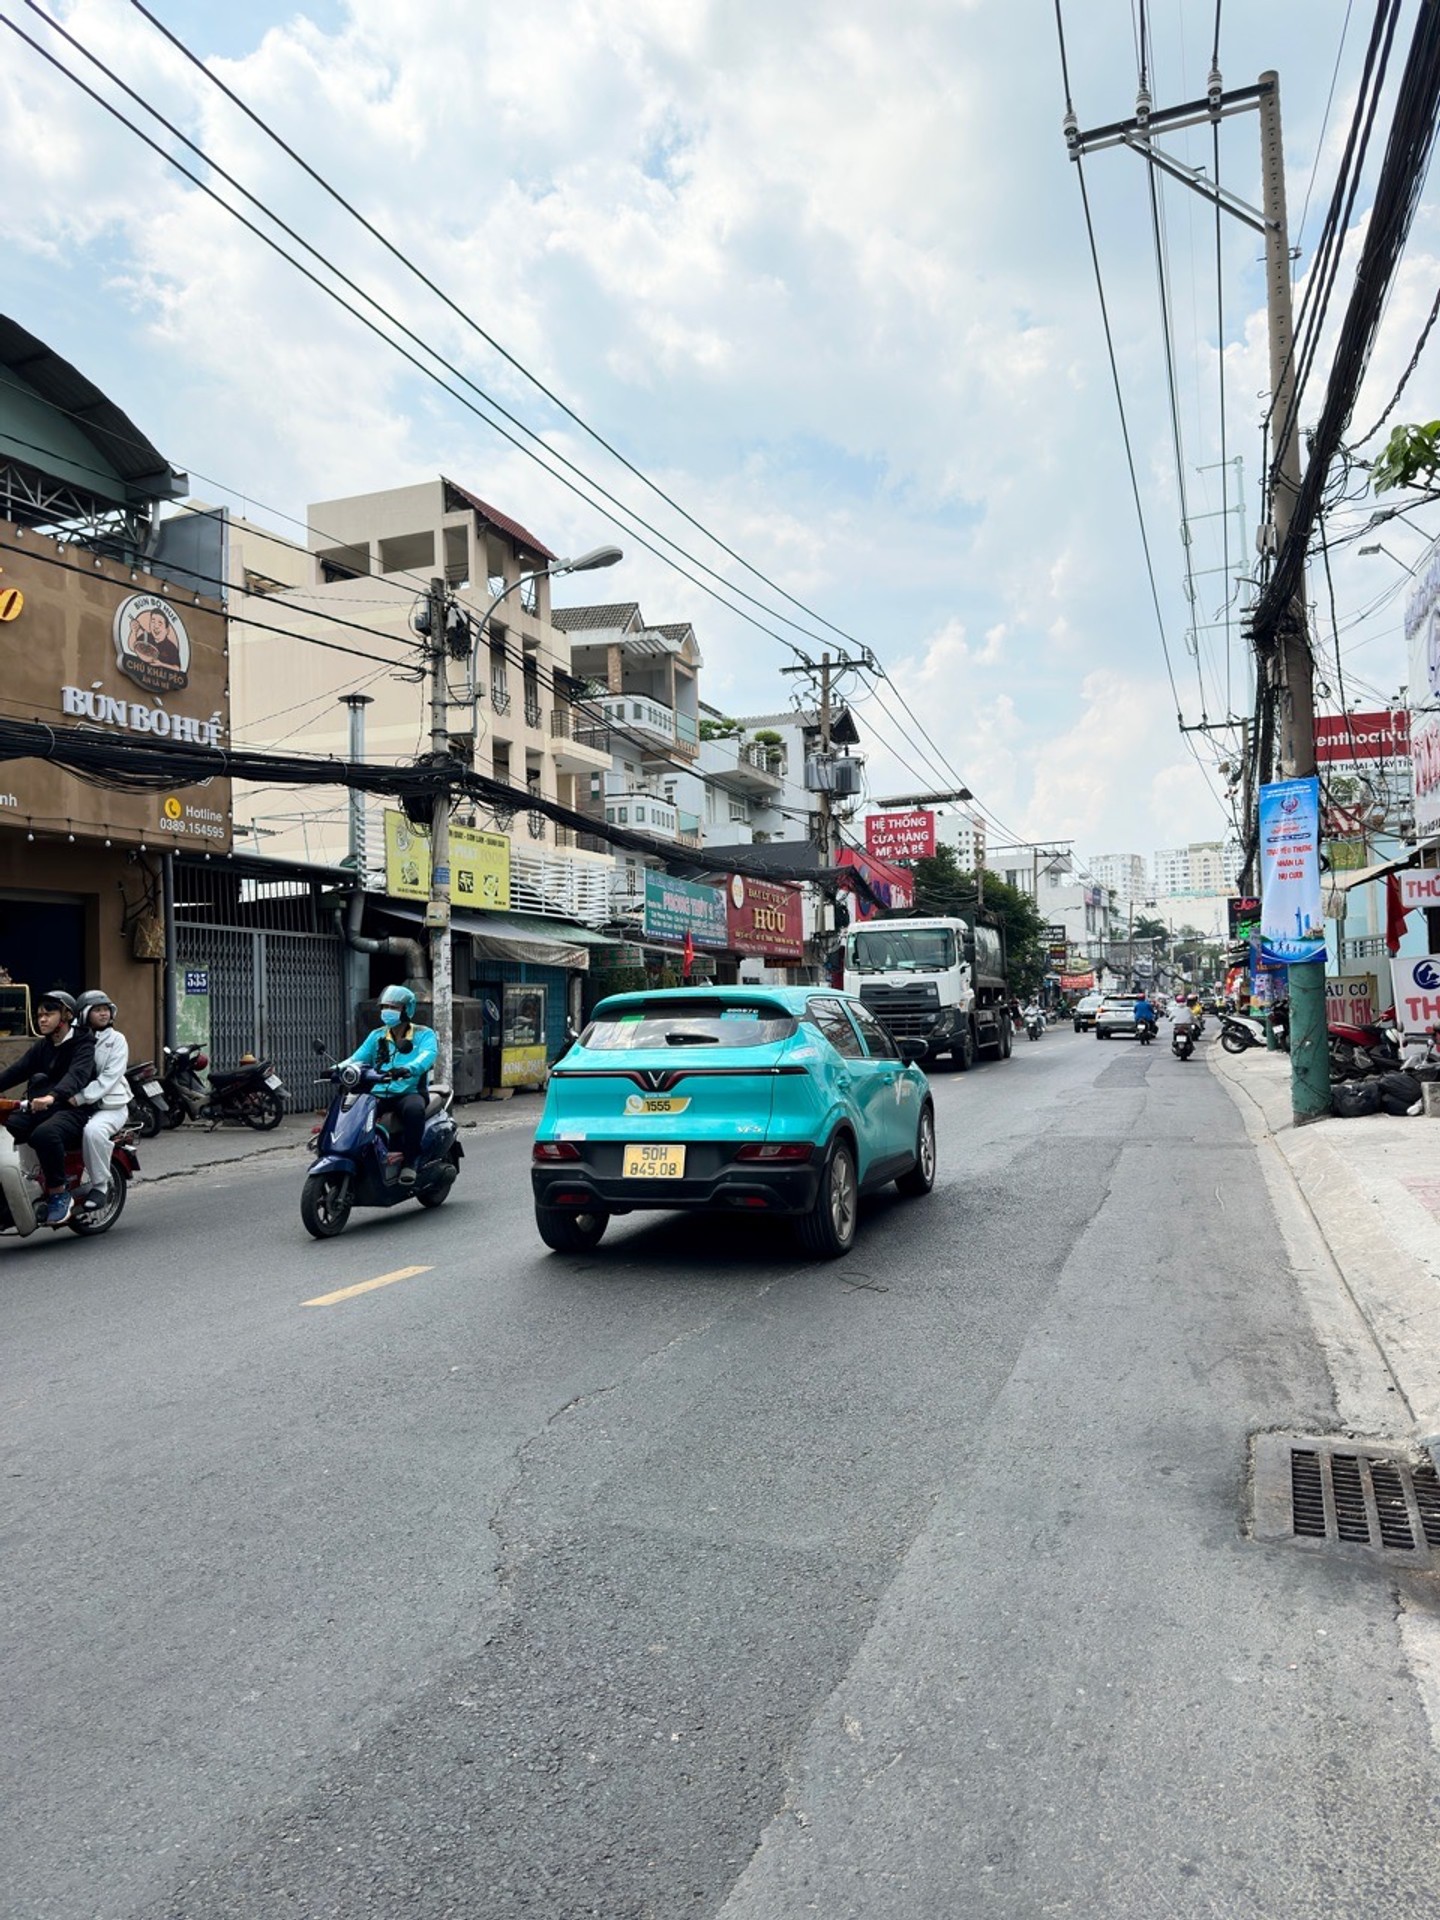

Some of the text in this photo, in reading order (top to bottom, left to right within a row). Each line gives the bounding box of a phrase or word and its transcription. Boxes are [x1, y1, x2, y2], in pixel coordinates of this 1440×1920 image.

[62, 681, 225, 748] BÚN BÒ HUẾ
[185, 805, 223, 822] Hotline
[160, 818, 224, 839] 0389.154595
[872, 813, 927, 832] HỆ THỐNG
[897, 830, 929, 841] HÀNG
[895, 843, 909, 855] VÀ
[911, 842, 925, 854] BÉ
[187, 973, 207, 987] 535
[646, 1101, 671, 1112] 1555
[641, 1147, 668, 1161] 50H
[630, 1162, 677, 1176] 845.08
